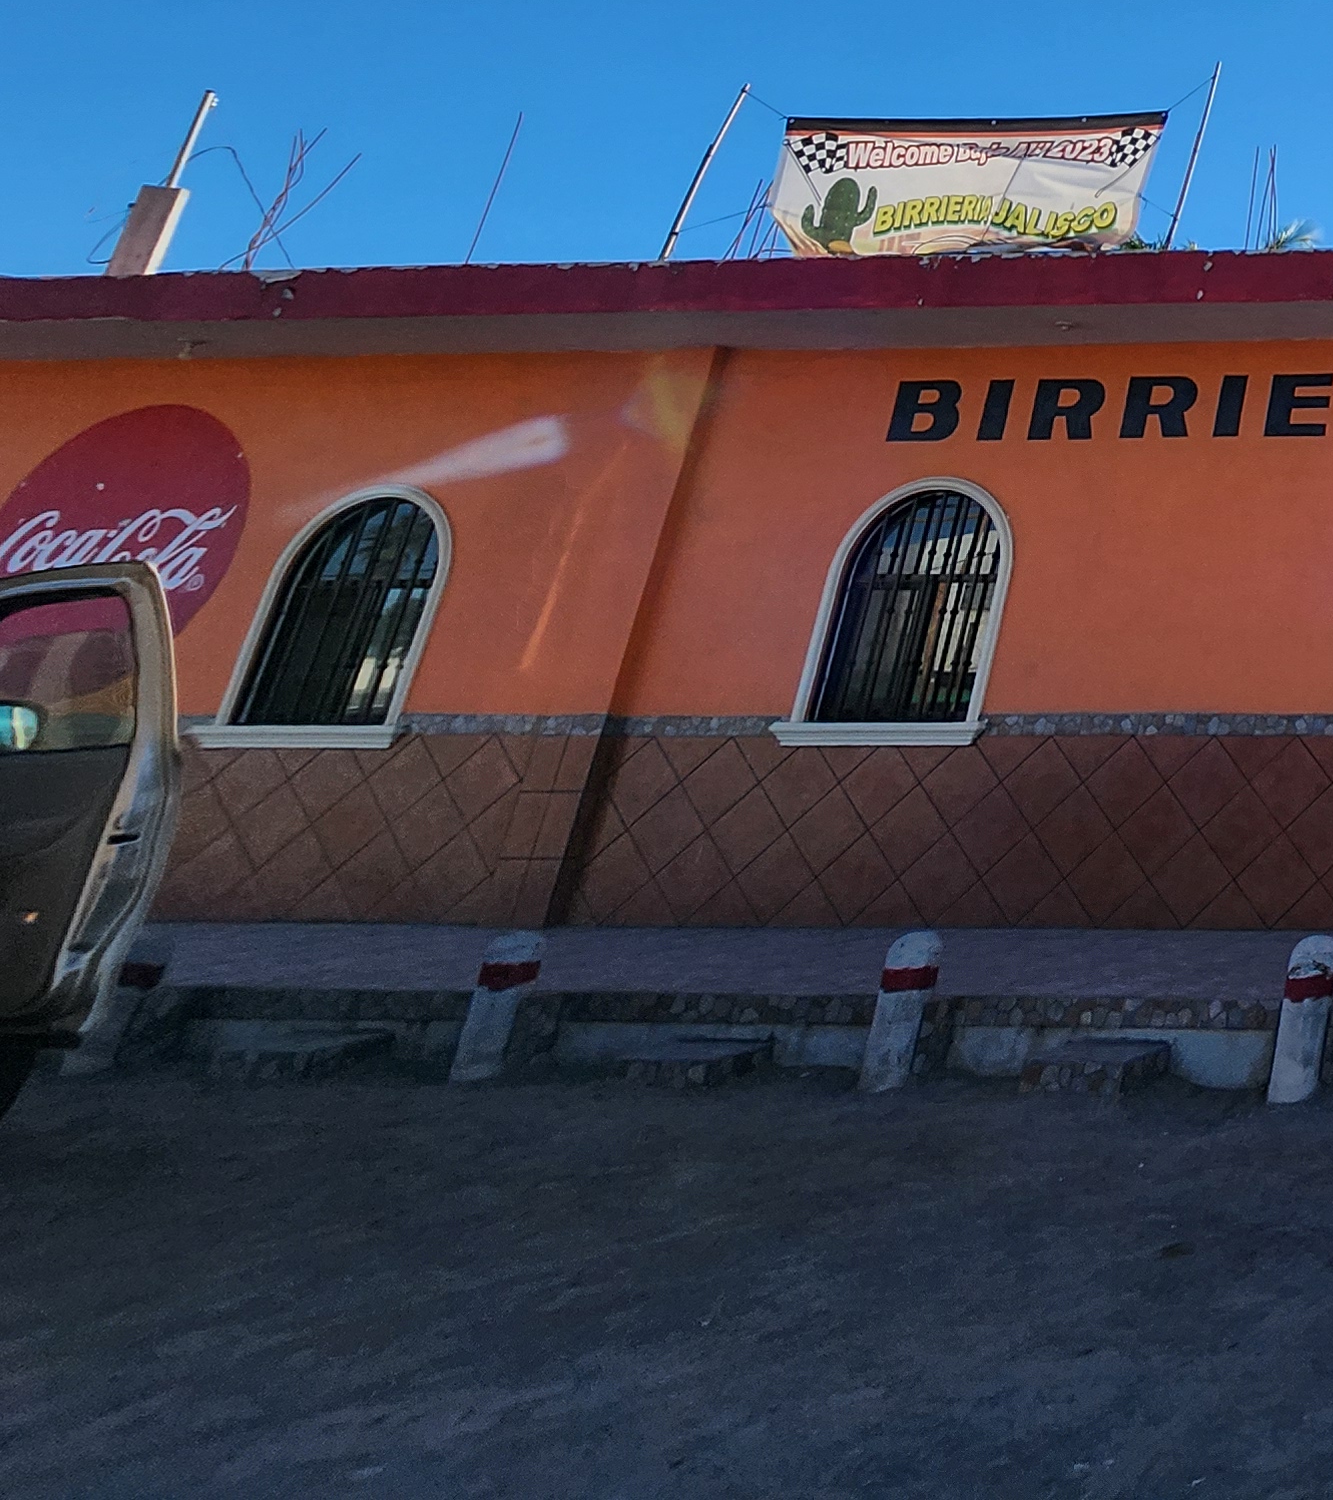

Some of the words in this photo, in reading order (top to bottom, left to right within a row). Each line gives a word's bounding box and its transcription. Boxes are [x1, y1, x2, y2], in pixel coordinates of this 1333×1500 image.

[846, 140, 955, 170] Welcome
[1042, 136, 1114, 164] 2023
[873, 194, 993, 235] BIRRIERIA
[992, 198, 1119, 238] JALISCO
